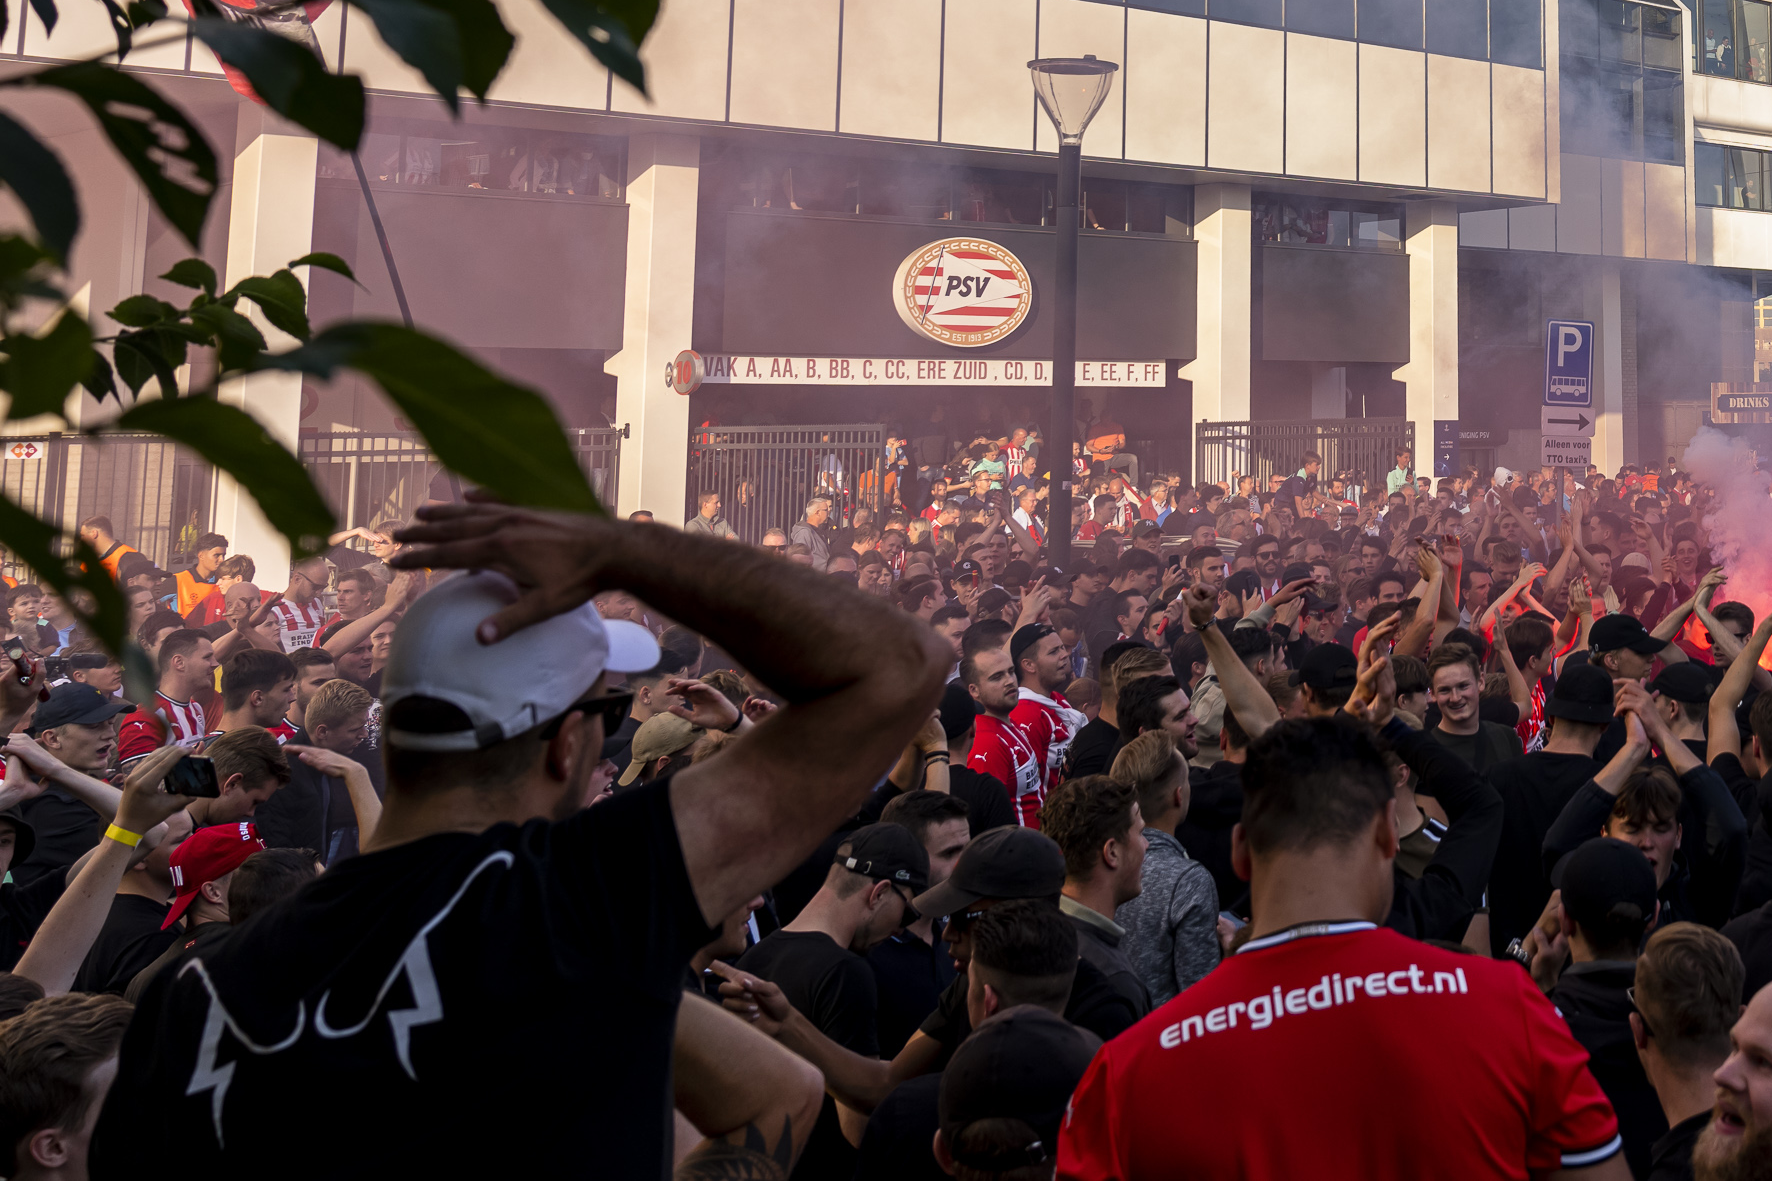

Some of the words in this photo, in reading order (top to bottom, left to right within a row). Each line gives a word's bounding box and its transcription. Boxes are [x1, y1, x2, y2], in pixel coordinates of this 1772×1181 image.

[945, 275, 991, 298] PSV
[952, 333, 966, 342] EST
[967, 333, 983, 343] 1913
[1557, 326, 1583, 367] P
[676, 360, 692, 385] 10
[704, 356, 738, 378] VAK
[745, 357, 763, 379] A,
[770, 357, 799, 380] AA,
[806, 358, 821, 381] B,
[829, 359, 855, 381] BB,
[862, 359, 878, 381] C,
[884, 360, 910, 381] CC,
[917, 360, 947, 380] ERE
[1004, 361, 1028, 382] CD,
[1034, 362, 1048, 383] D,
[1081, 362, 1095, 383] E,
[1100, 362, 1121, 384] EE,
[1126, 363, 1139, 384] F,
[1144, 363, 1160, 383] FF
[1729, 396, 1770, 408] DRINKS
[1480, 431, 1490, 439] PSV
[1544, 439, 1571, 449] Alleen
[1572, 440, 1590, 449] voor
[1546, 454, 1564, 464] TTO
[1565, 455, 1588, 464] taxi's
[1159, 963, 1468, 1050] energiedirect.nl
